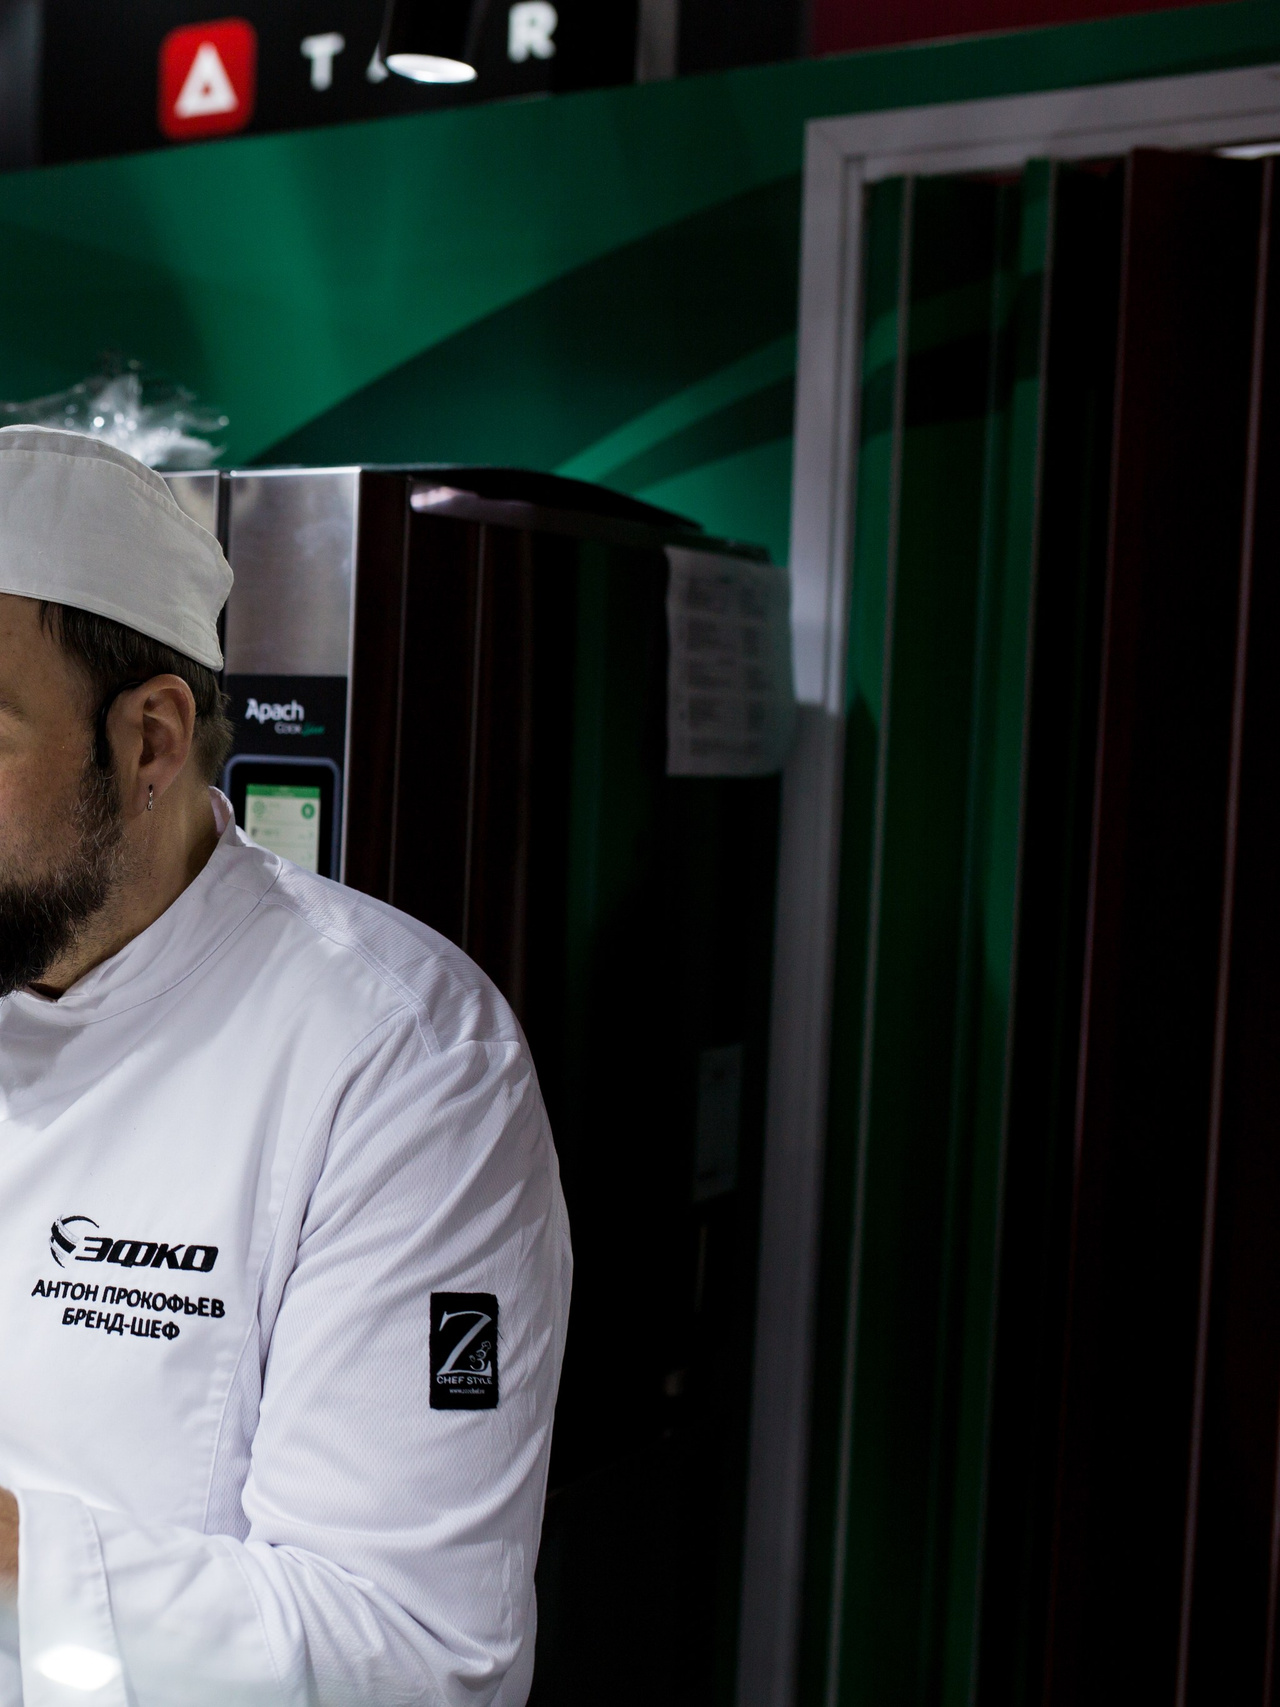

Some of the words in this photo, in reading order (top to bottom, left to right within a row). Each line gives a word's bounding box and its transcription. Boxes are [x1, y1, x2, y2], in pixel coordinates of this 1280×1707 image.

[245, 698, 304, 724] Apach
[75, 1236, 219, 1272] ЭФКО
[31, 1279, 99, 1301] АНТОН
[101, 1286, 225, 1318] ПРОКОФЬЕВ
[62, 1307, 180, 1340] БРЕНД-ШЕФ
[437, 1376, 464, 1384] CHEF
[467, 1377, 492, 1385] STYLE
